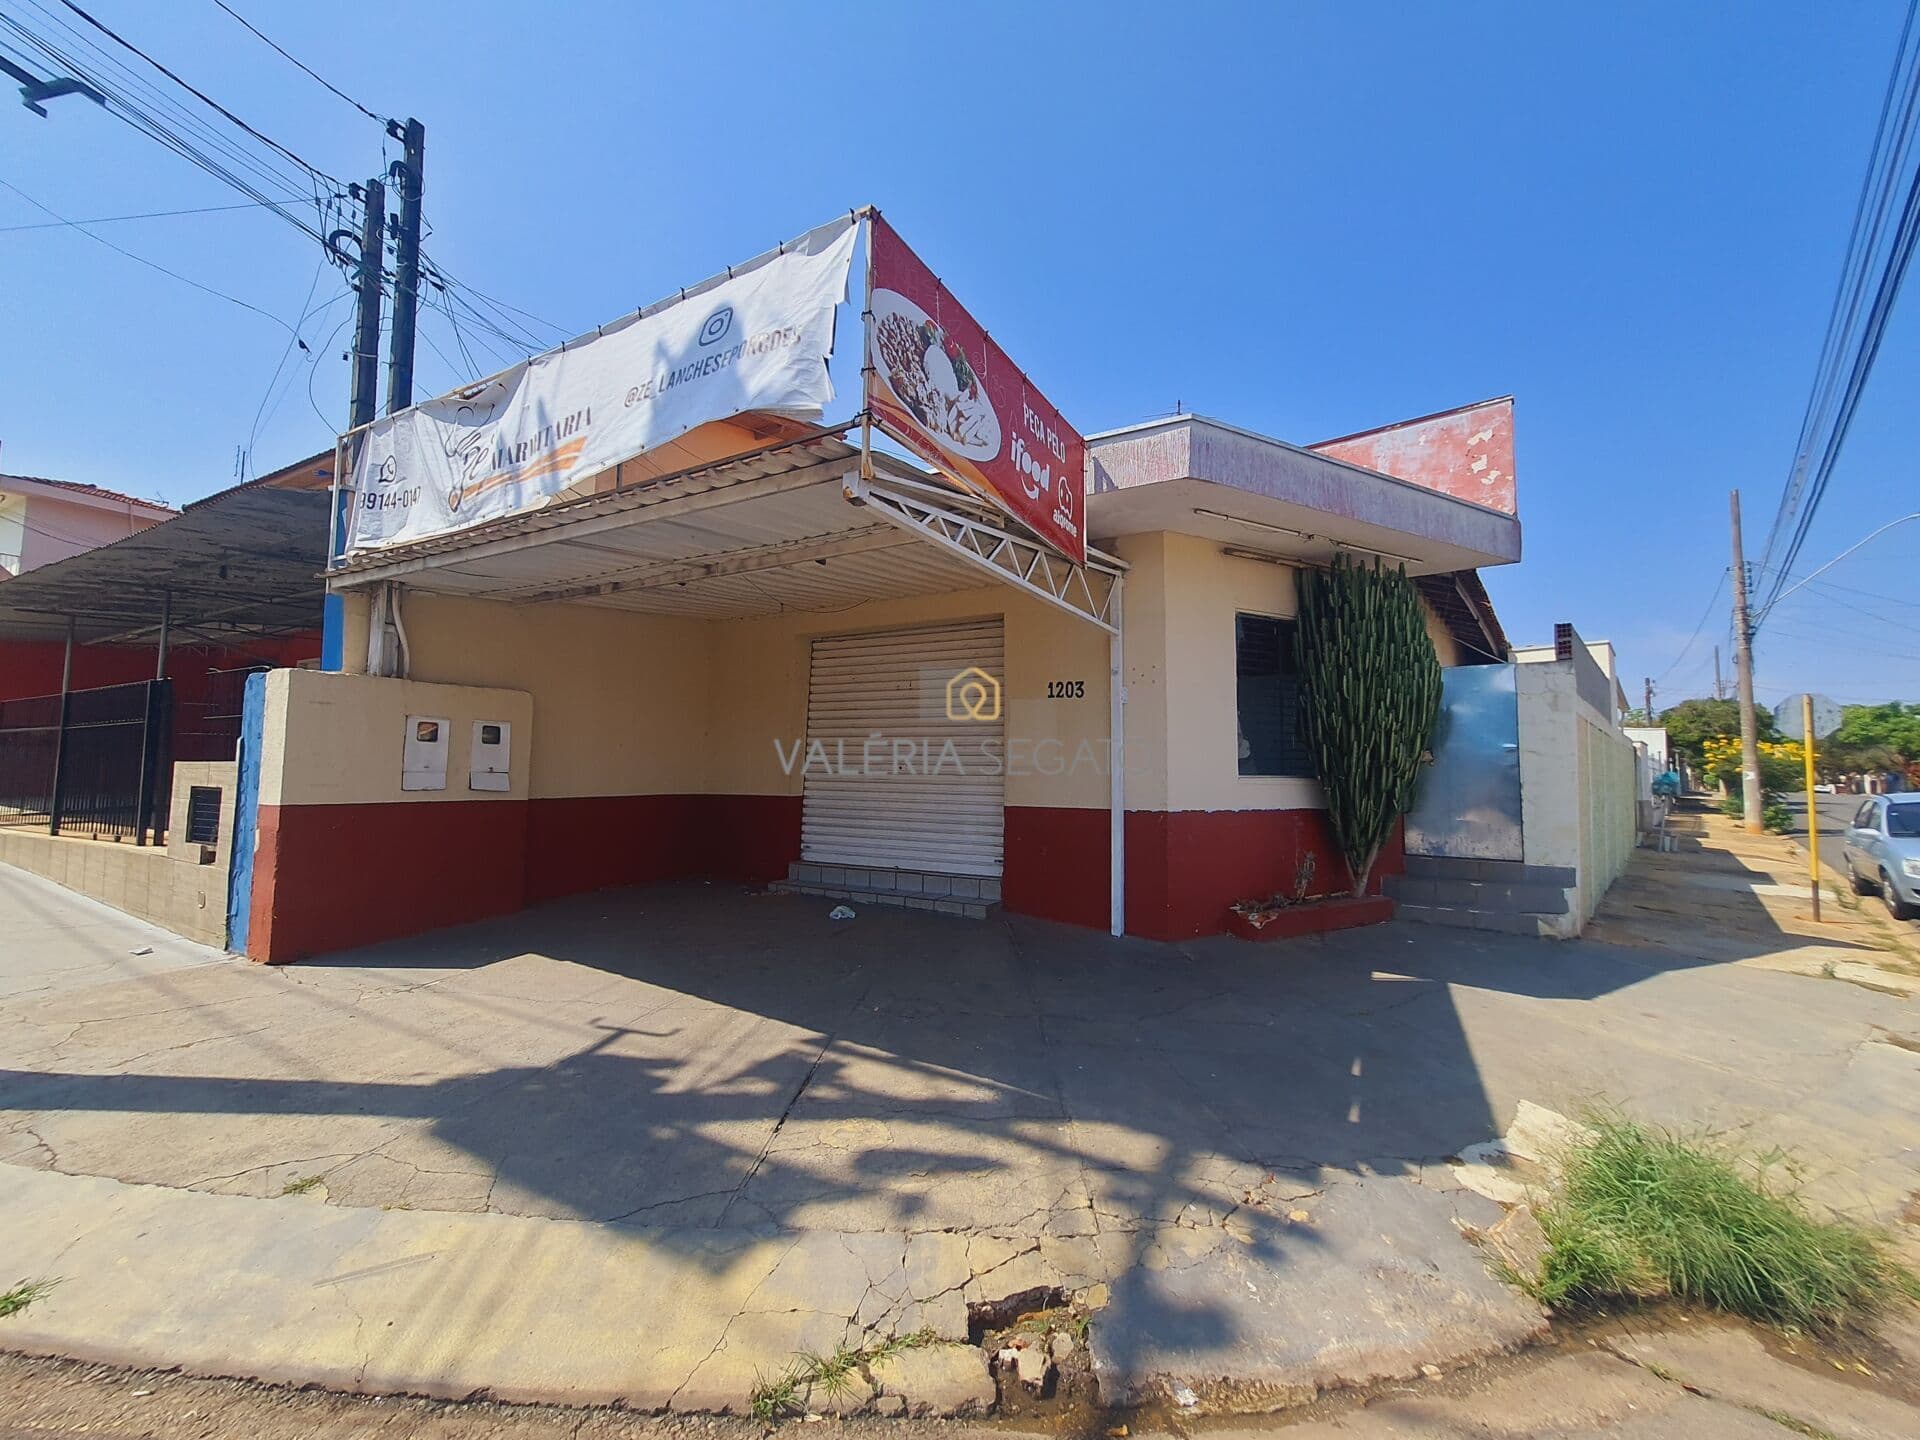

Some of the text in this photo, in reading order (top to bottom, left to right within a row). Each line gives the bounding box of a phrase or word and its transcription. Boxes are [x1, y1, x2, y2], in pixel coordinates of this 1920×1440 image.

[1023, 402, 1066, 464] PEÇA PELO
[1047, 680, 1085, 699] 1203
